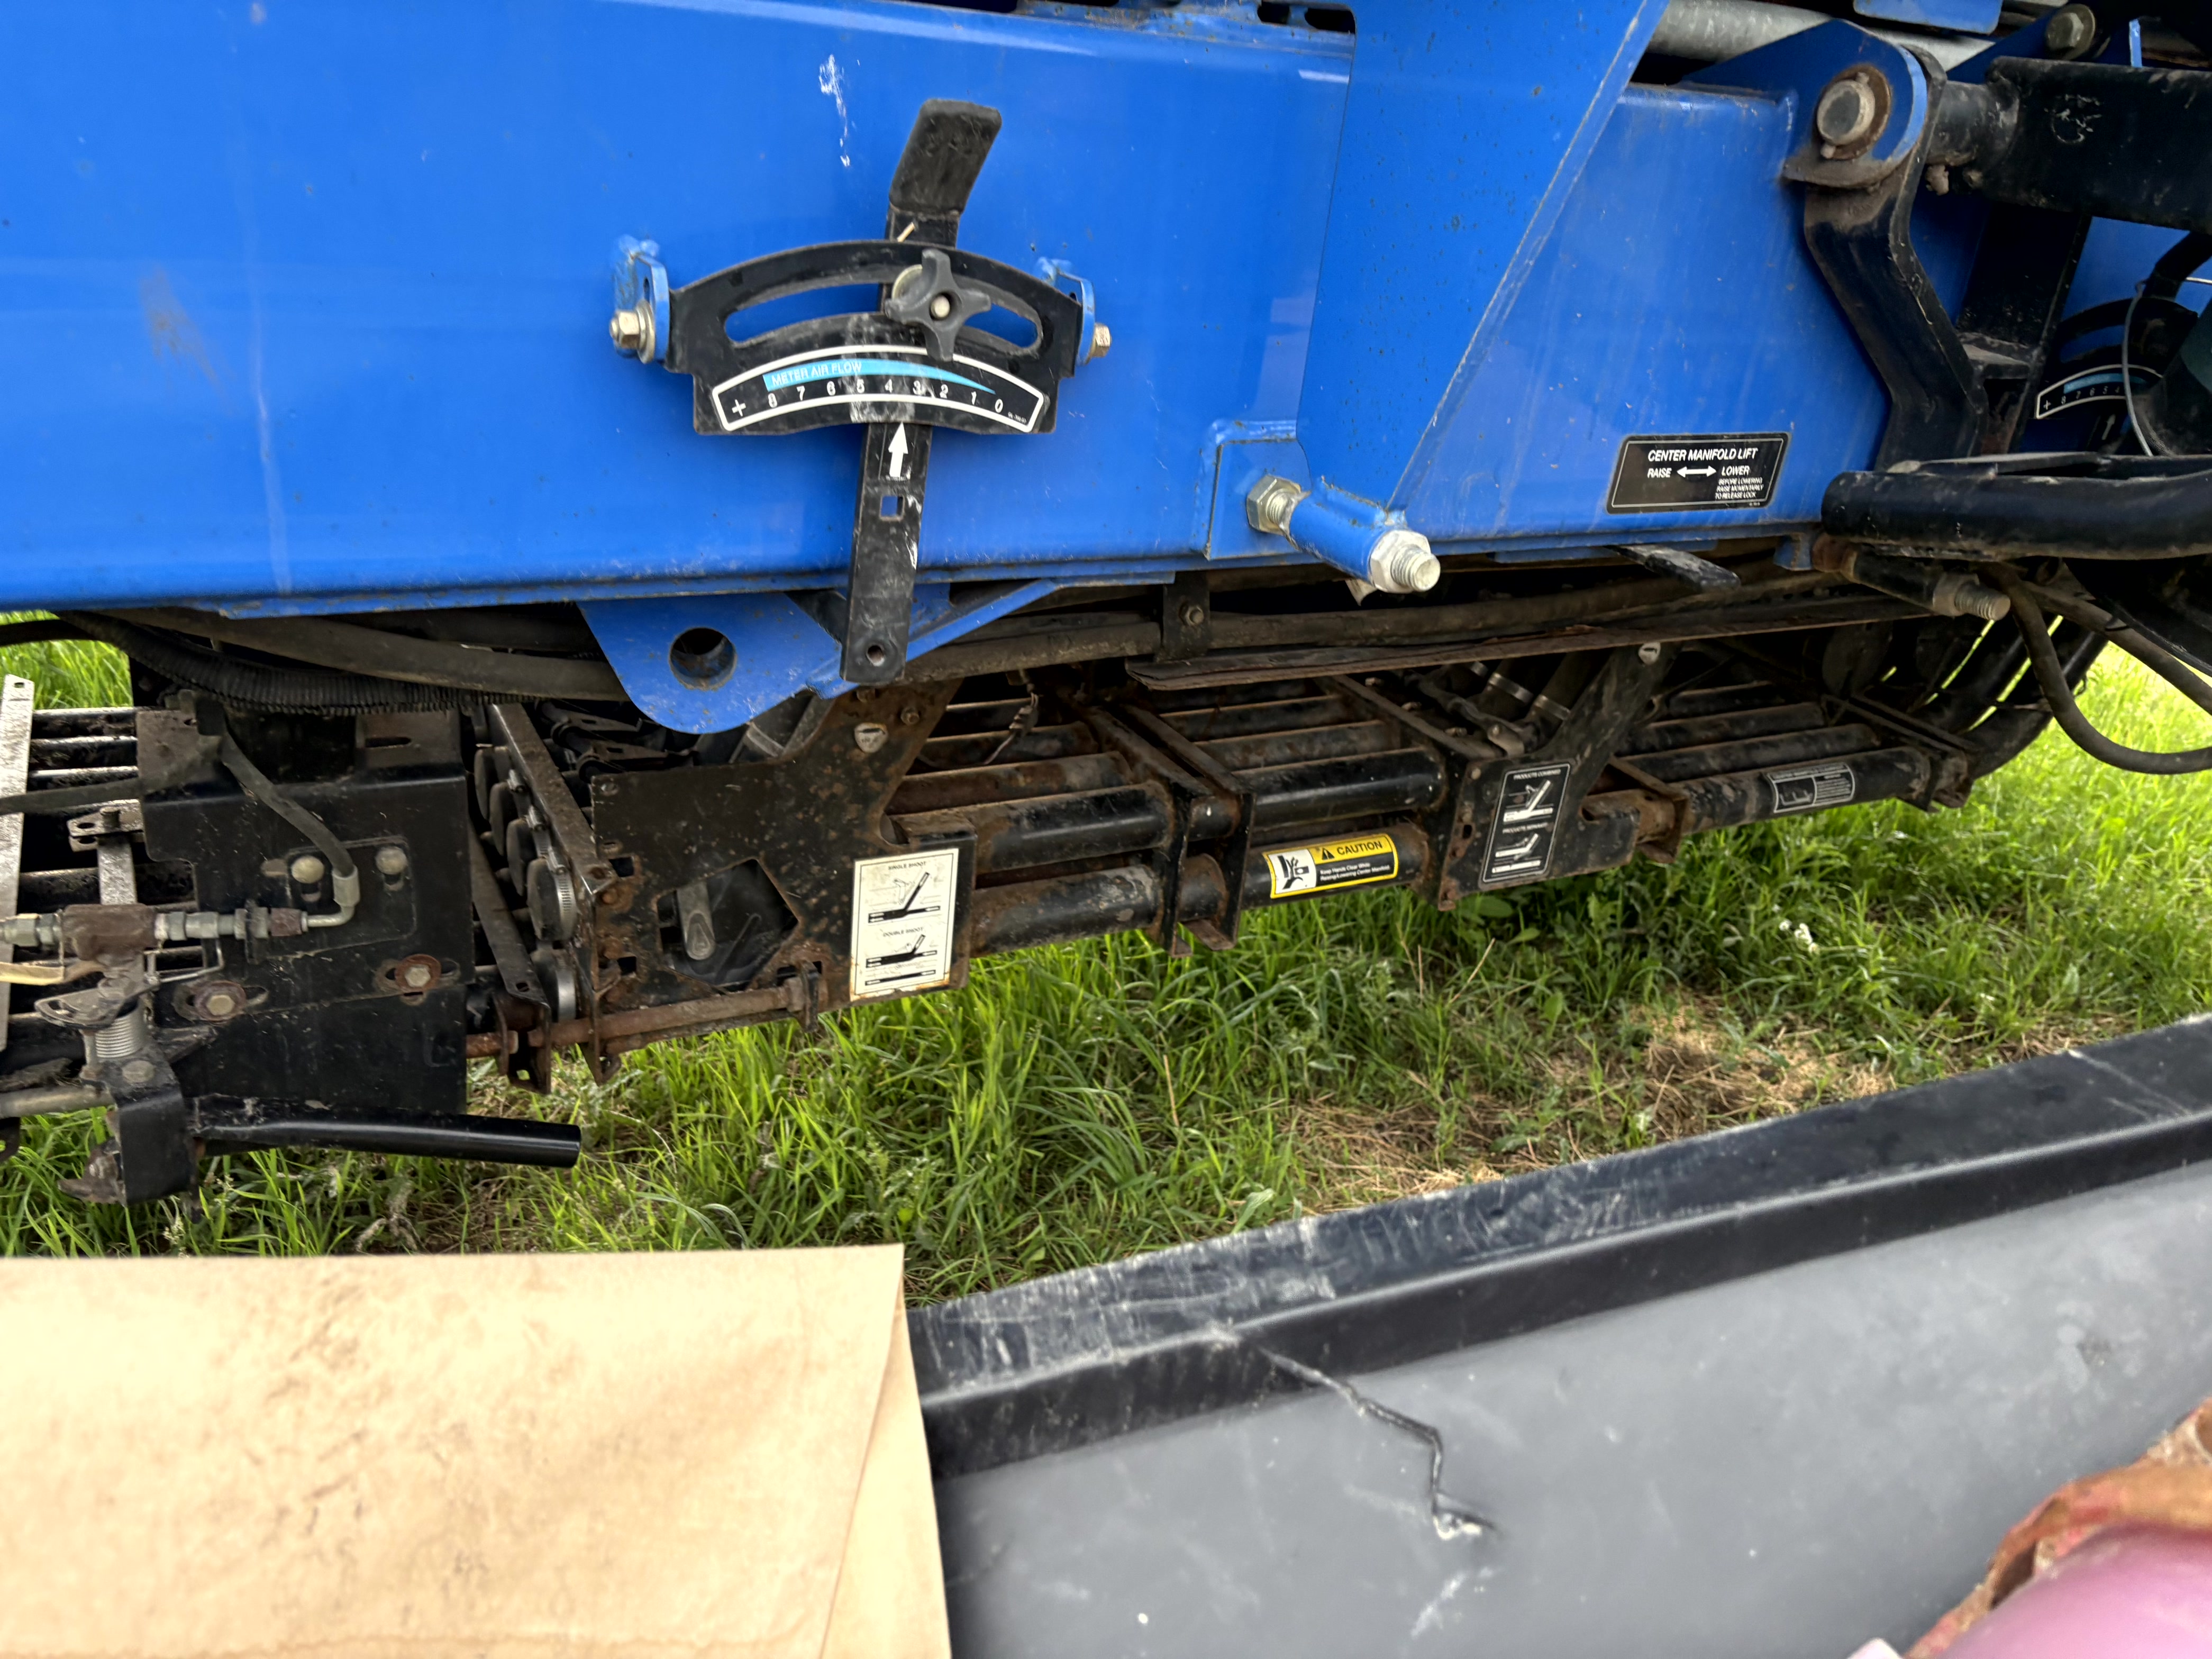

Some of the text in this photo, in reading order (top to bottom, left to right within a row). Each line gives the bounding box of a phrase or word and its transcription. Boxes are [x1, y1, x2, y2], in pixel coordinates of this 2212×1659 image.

[771, 361, 862, 386] METER AIR FLOW
[796, 385, 805, 401] 7
[826, 381, 836, 396] 6
[857, 379, 865, 393] 5
[885, 379, 893, 393] 4
[913, 380, 922, 395] 3
[940, 384, 949, 398] 2
[971, 391, 977, 405] 1
[995, 398, 1004, 413] 0
[1648, 448, 1758, 462] CENTER MANIFOLD LIFT
[1647, 466, 1750, 478] RAISE LOWER
[1337, 841, 1383, 855] CAUTION
